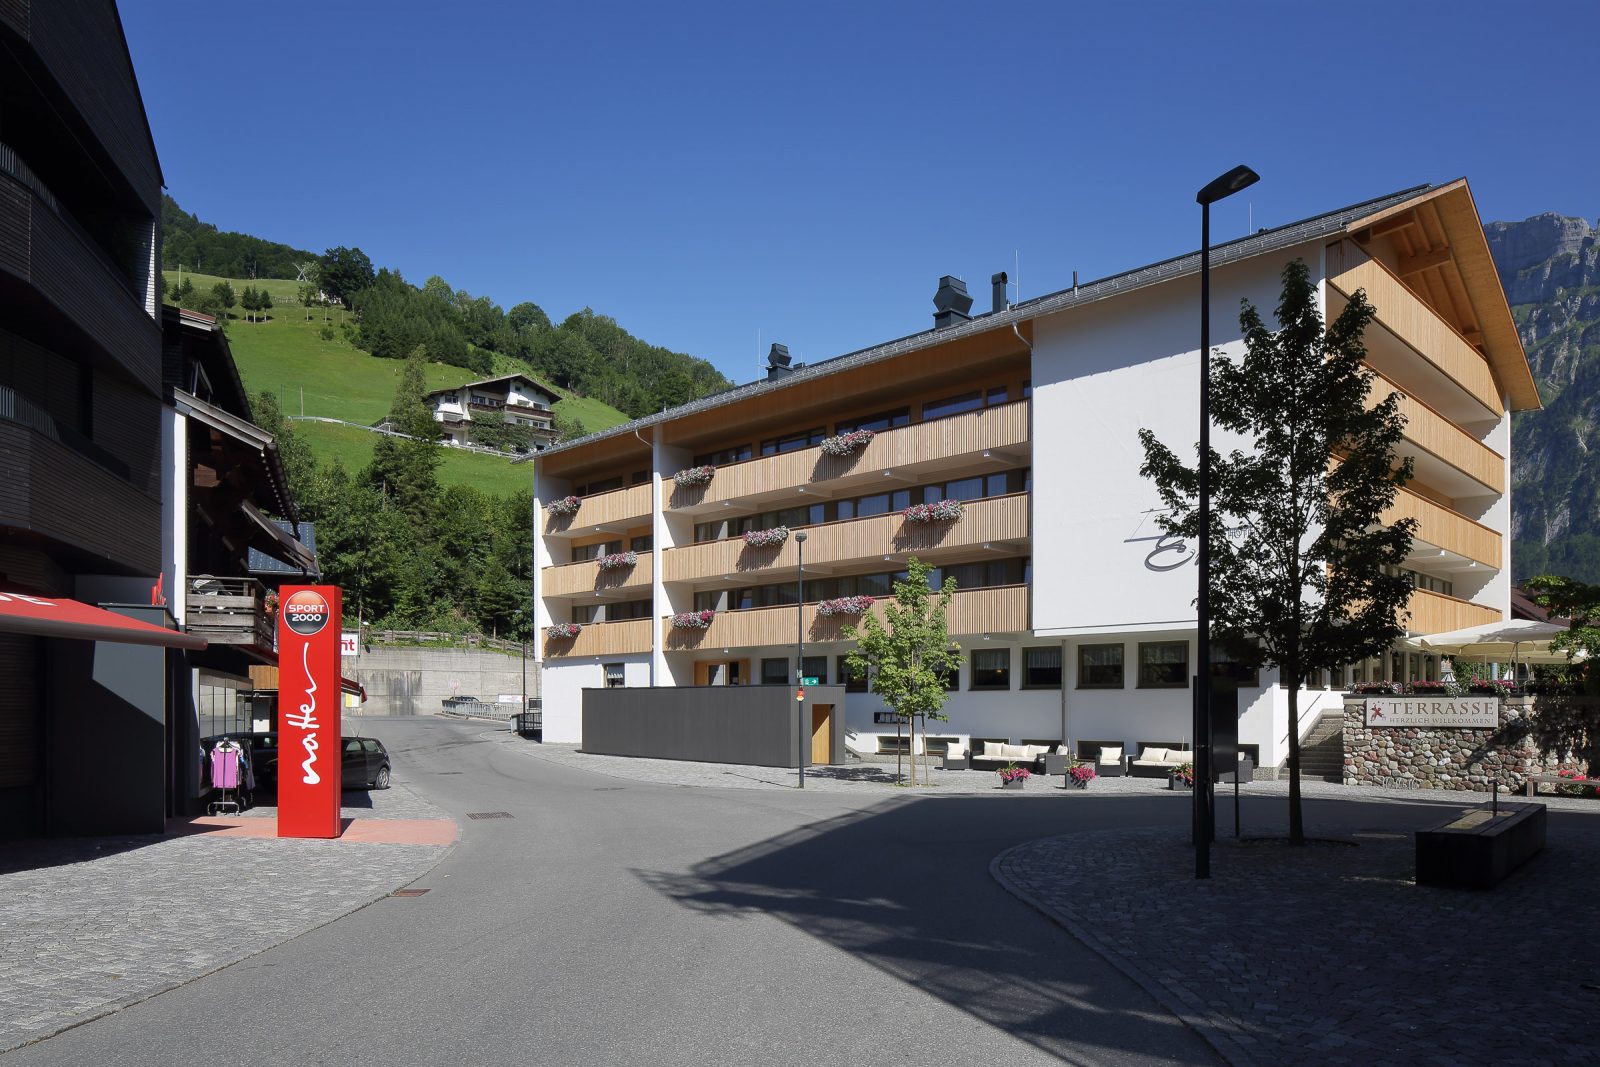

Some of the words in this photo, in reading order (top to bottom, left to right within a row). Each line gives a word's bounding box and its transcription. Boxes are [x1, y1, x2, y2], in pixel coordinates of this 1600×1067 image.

[288, 604, 325, 613] SPORT
[292, 613, 322, 622] 2000
[1389, 702, 1494, 715] TERRASSE
[1389, 717, 1430, 725] HERZLICH
